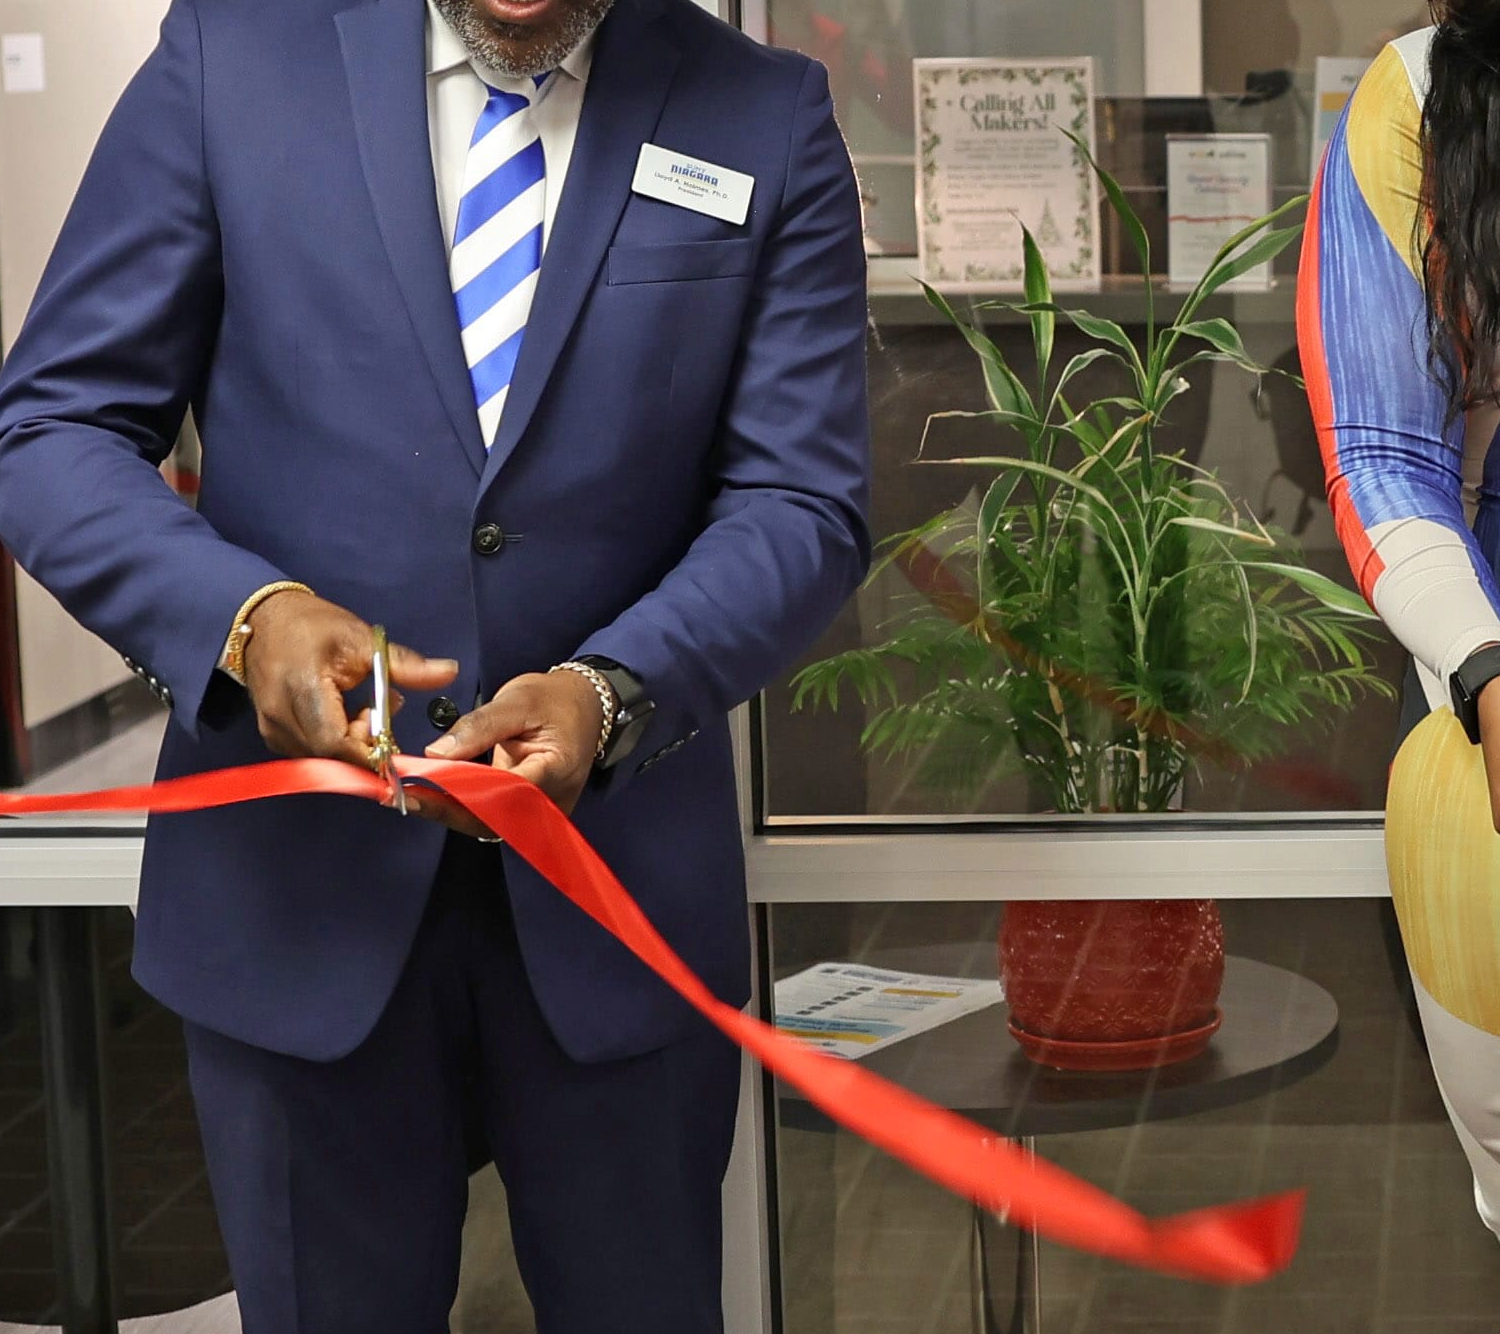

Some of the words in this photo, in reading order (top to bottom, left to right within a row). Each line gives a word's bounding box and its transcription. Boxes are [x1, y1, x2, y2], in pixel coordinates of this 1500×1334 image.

[959, 93, 1024, 115] Calling
[1029, 93, 1056, 110] All
[971, 114, 1048, 131] Makers!
[670, 164, 719, 187] NIAGARA
